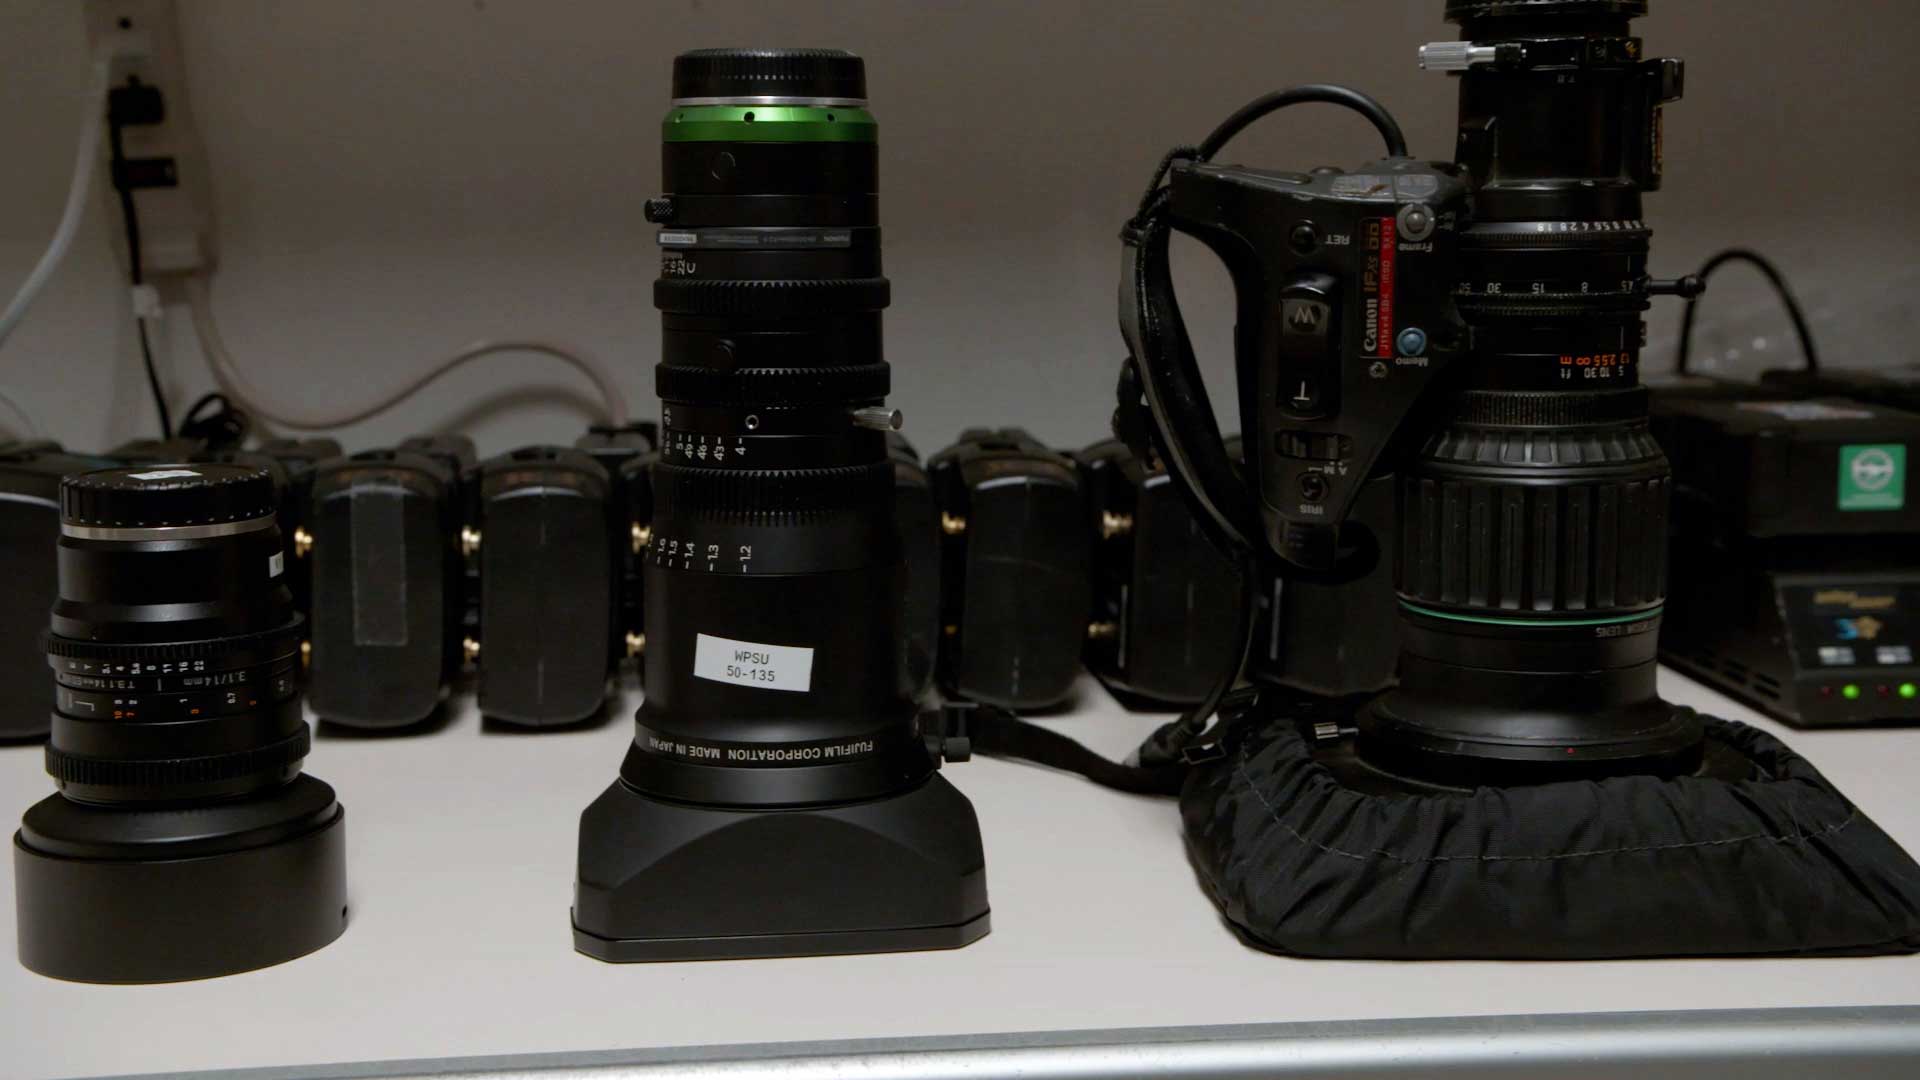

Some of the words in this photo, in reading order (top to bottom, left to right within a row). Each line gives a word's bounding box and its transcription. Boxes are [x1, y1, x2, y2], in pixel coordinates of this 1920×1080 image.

[1325, 234, 1350, 245] RET
[1398, 242, 1433, 252] Frame
[1486, 282, 1502, 294] 30
[1531, 282, 1545, 294] 15
[1581, 281, 1589, 293] 8
[1363, 298, 1378, 351] Canon
[1560, 368, 1571, 380] ft
[1583, 367, 1598, 379] 30
[734, 446, 747, 456] 4
[1299, 503, 1324, 515] IRIS
[707, 544, 719, 561] 1.3
[739, 545, 752, 561] 1.2
[734, 650, 770, 665] WPSU
[726, 665, 776, 682] 50-135
[648, 736, 674, 752] JAPAN
[675, 743, 687, 755] IN
[824, 740, 874, 758] FUJIFILM
[689, 745, 721, 759] MADE
[727, 747, 822, 760] CORPORATION
